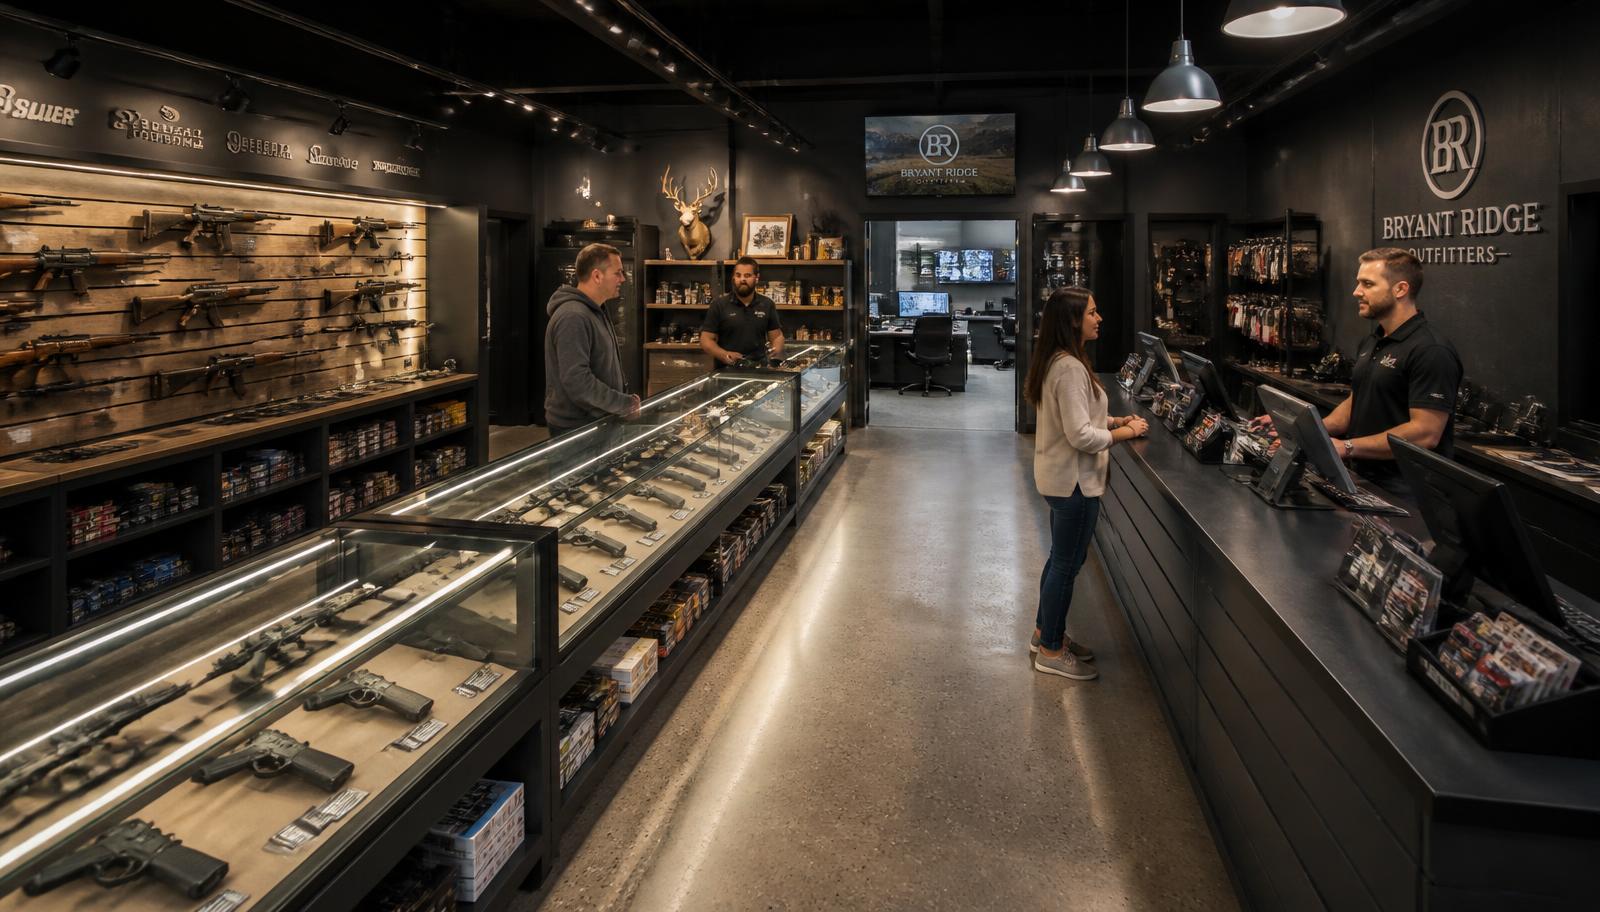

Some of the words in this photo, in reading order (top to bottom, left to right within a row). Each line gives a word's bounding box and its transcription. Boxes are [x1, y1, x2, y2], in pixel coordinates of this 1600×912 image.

[925, 134, 952, 157] BR
[1430, 115, 1475, 175] BR
[901, 168, 943, 177] BRYANT
[945, 168, 978, 177] RIDGE
[1382, 210, 1455, 240] BRYANT
[1460, 202, 1540, 236] RIDGE
